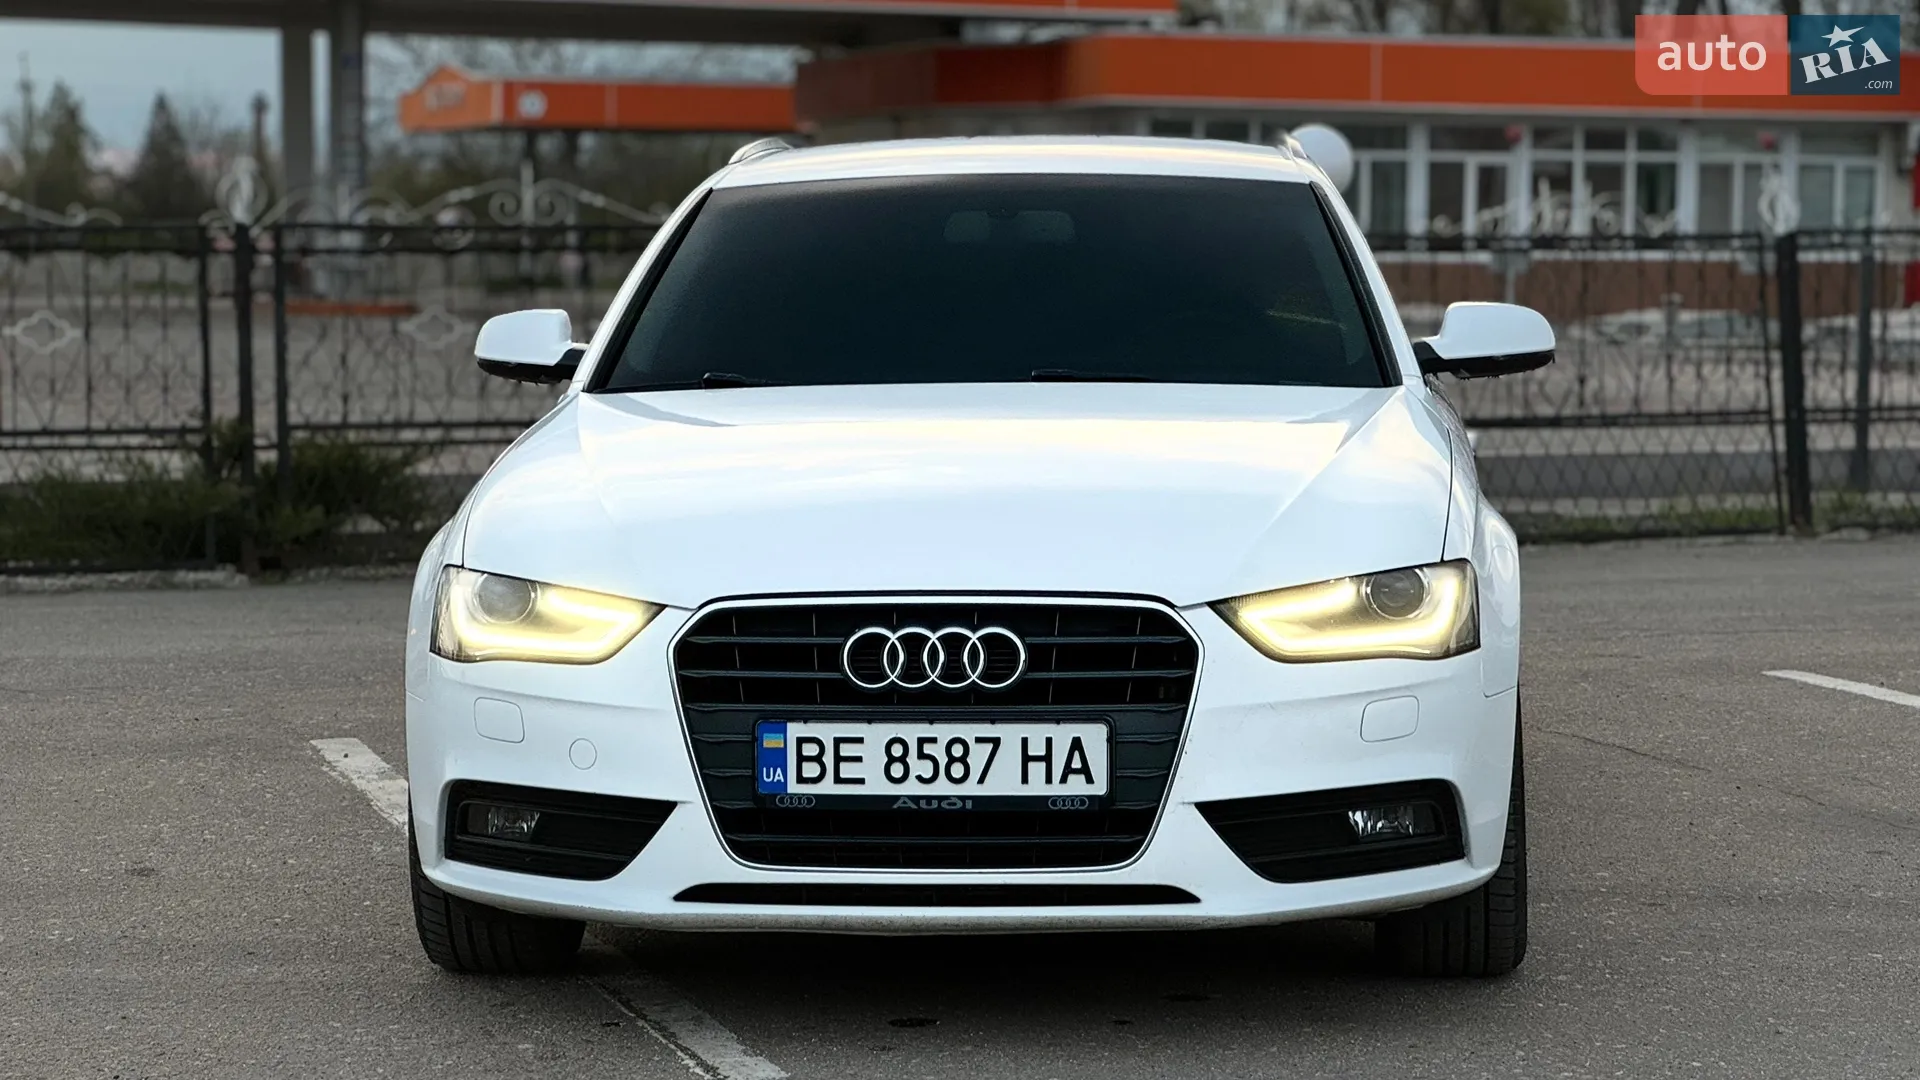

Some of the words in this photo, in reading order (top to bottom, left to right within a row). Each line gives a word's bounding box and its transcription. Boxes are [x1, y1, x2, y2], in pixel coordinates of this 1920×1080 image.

[763, 767, 784, 783] UA
[795, 736, 866, 785] BE
[883, 736, 1001, 785] 8587
[1020, 736, 1095, 785] HA
